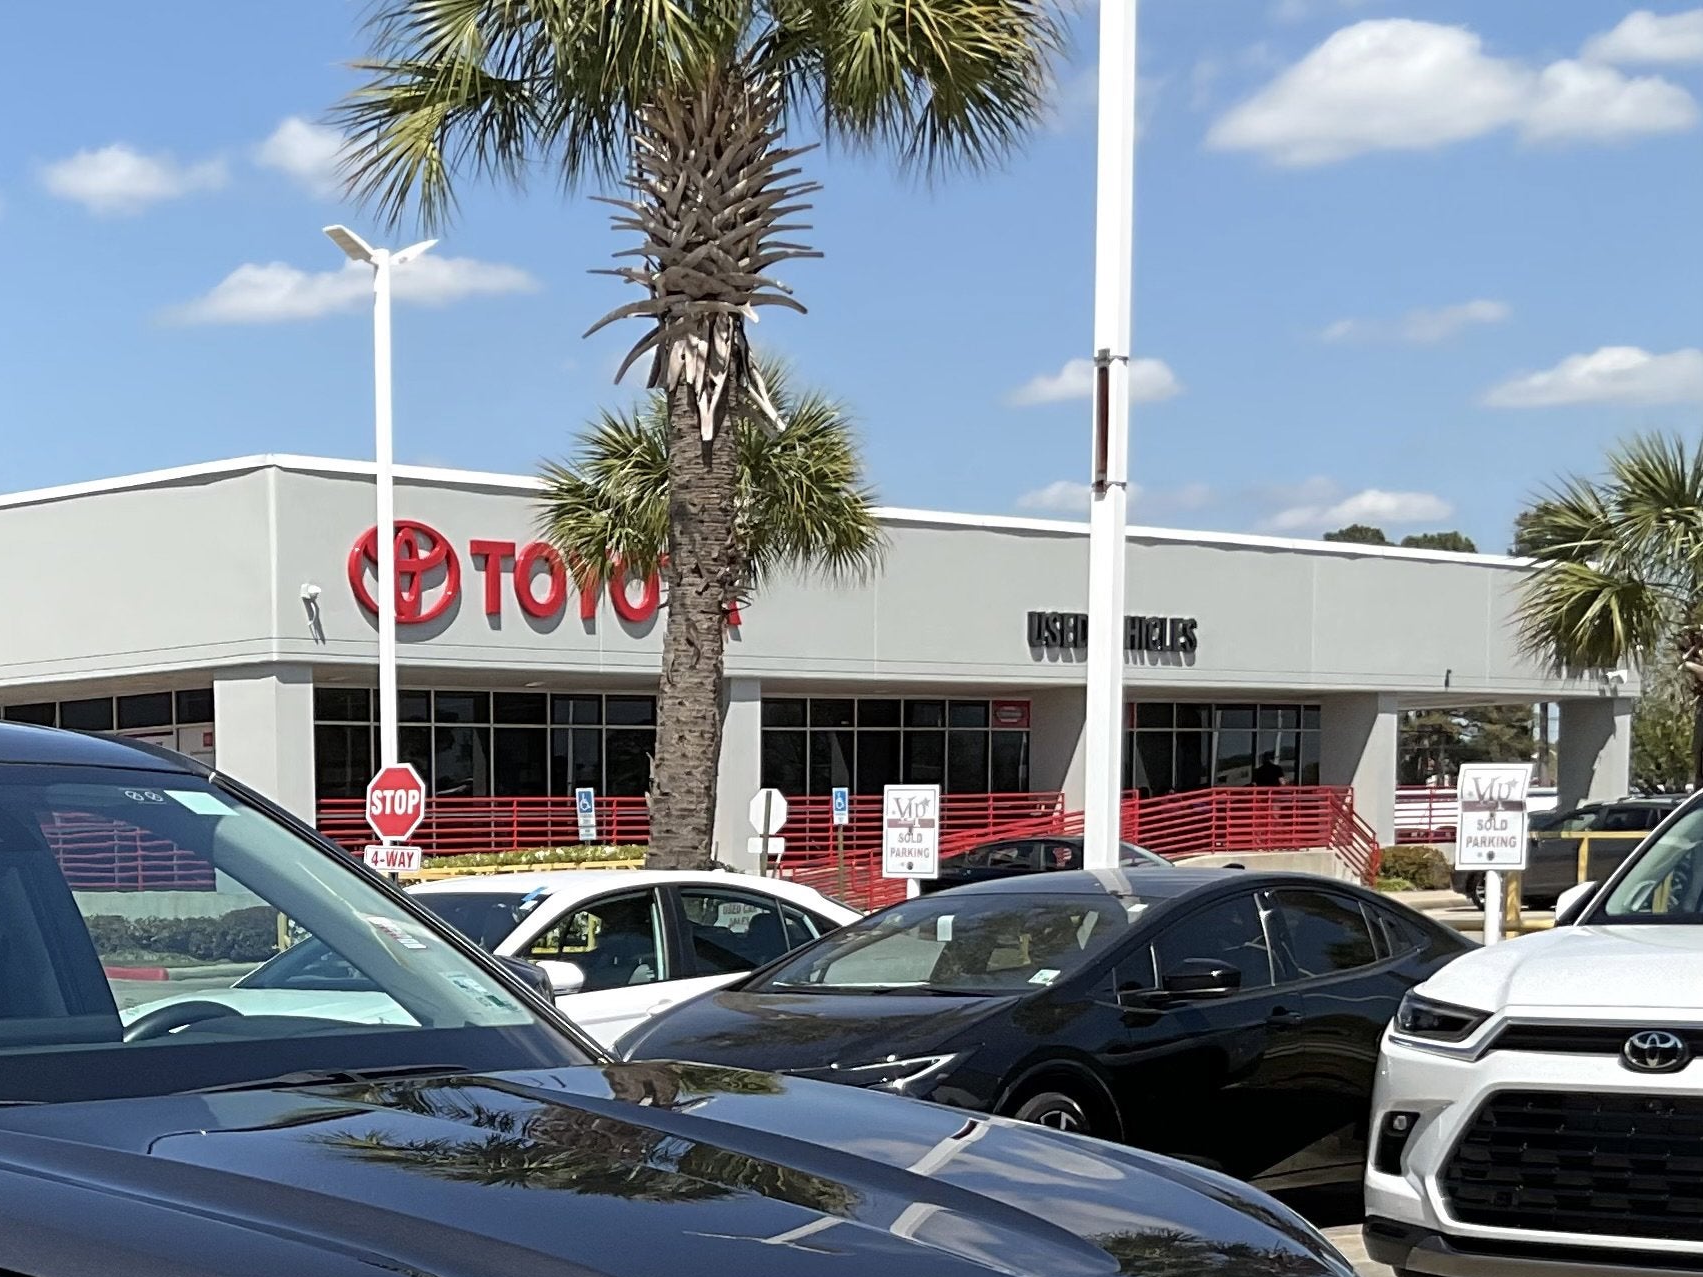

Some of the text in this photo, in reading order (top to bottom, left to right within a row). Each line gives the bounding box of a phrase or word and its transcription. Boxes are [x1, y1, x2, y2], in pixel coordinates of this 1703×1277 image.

[1027, 611, 1197, 651] USED HICLES
[371, 789, 420, 815] STOP
[1477, 819, 1508, 831] SOLD
[898, 833, 923, 843] SOLD
[1466, 836, 1517, 848] PARKING
[890, 847, 930, 858] PARKING
[371, 850, 415, 868] 4-WAY
